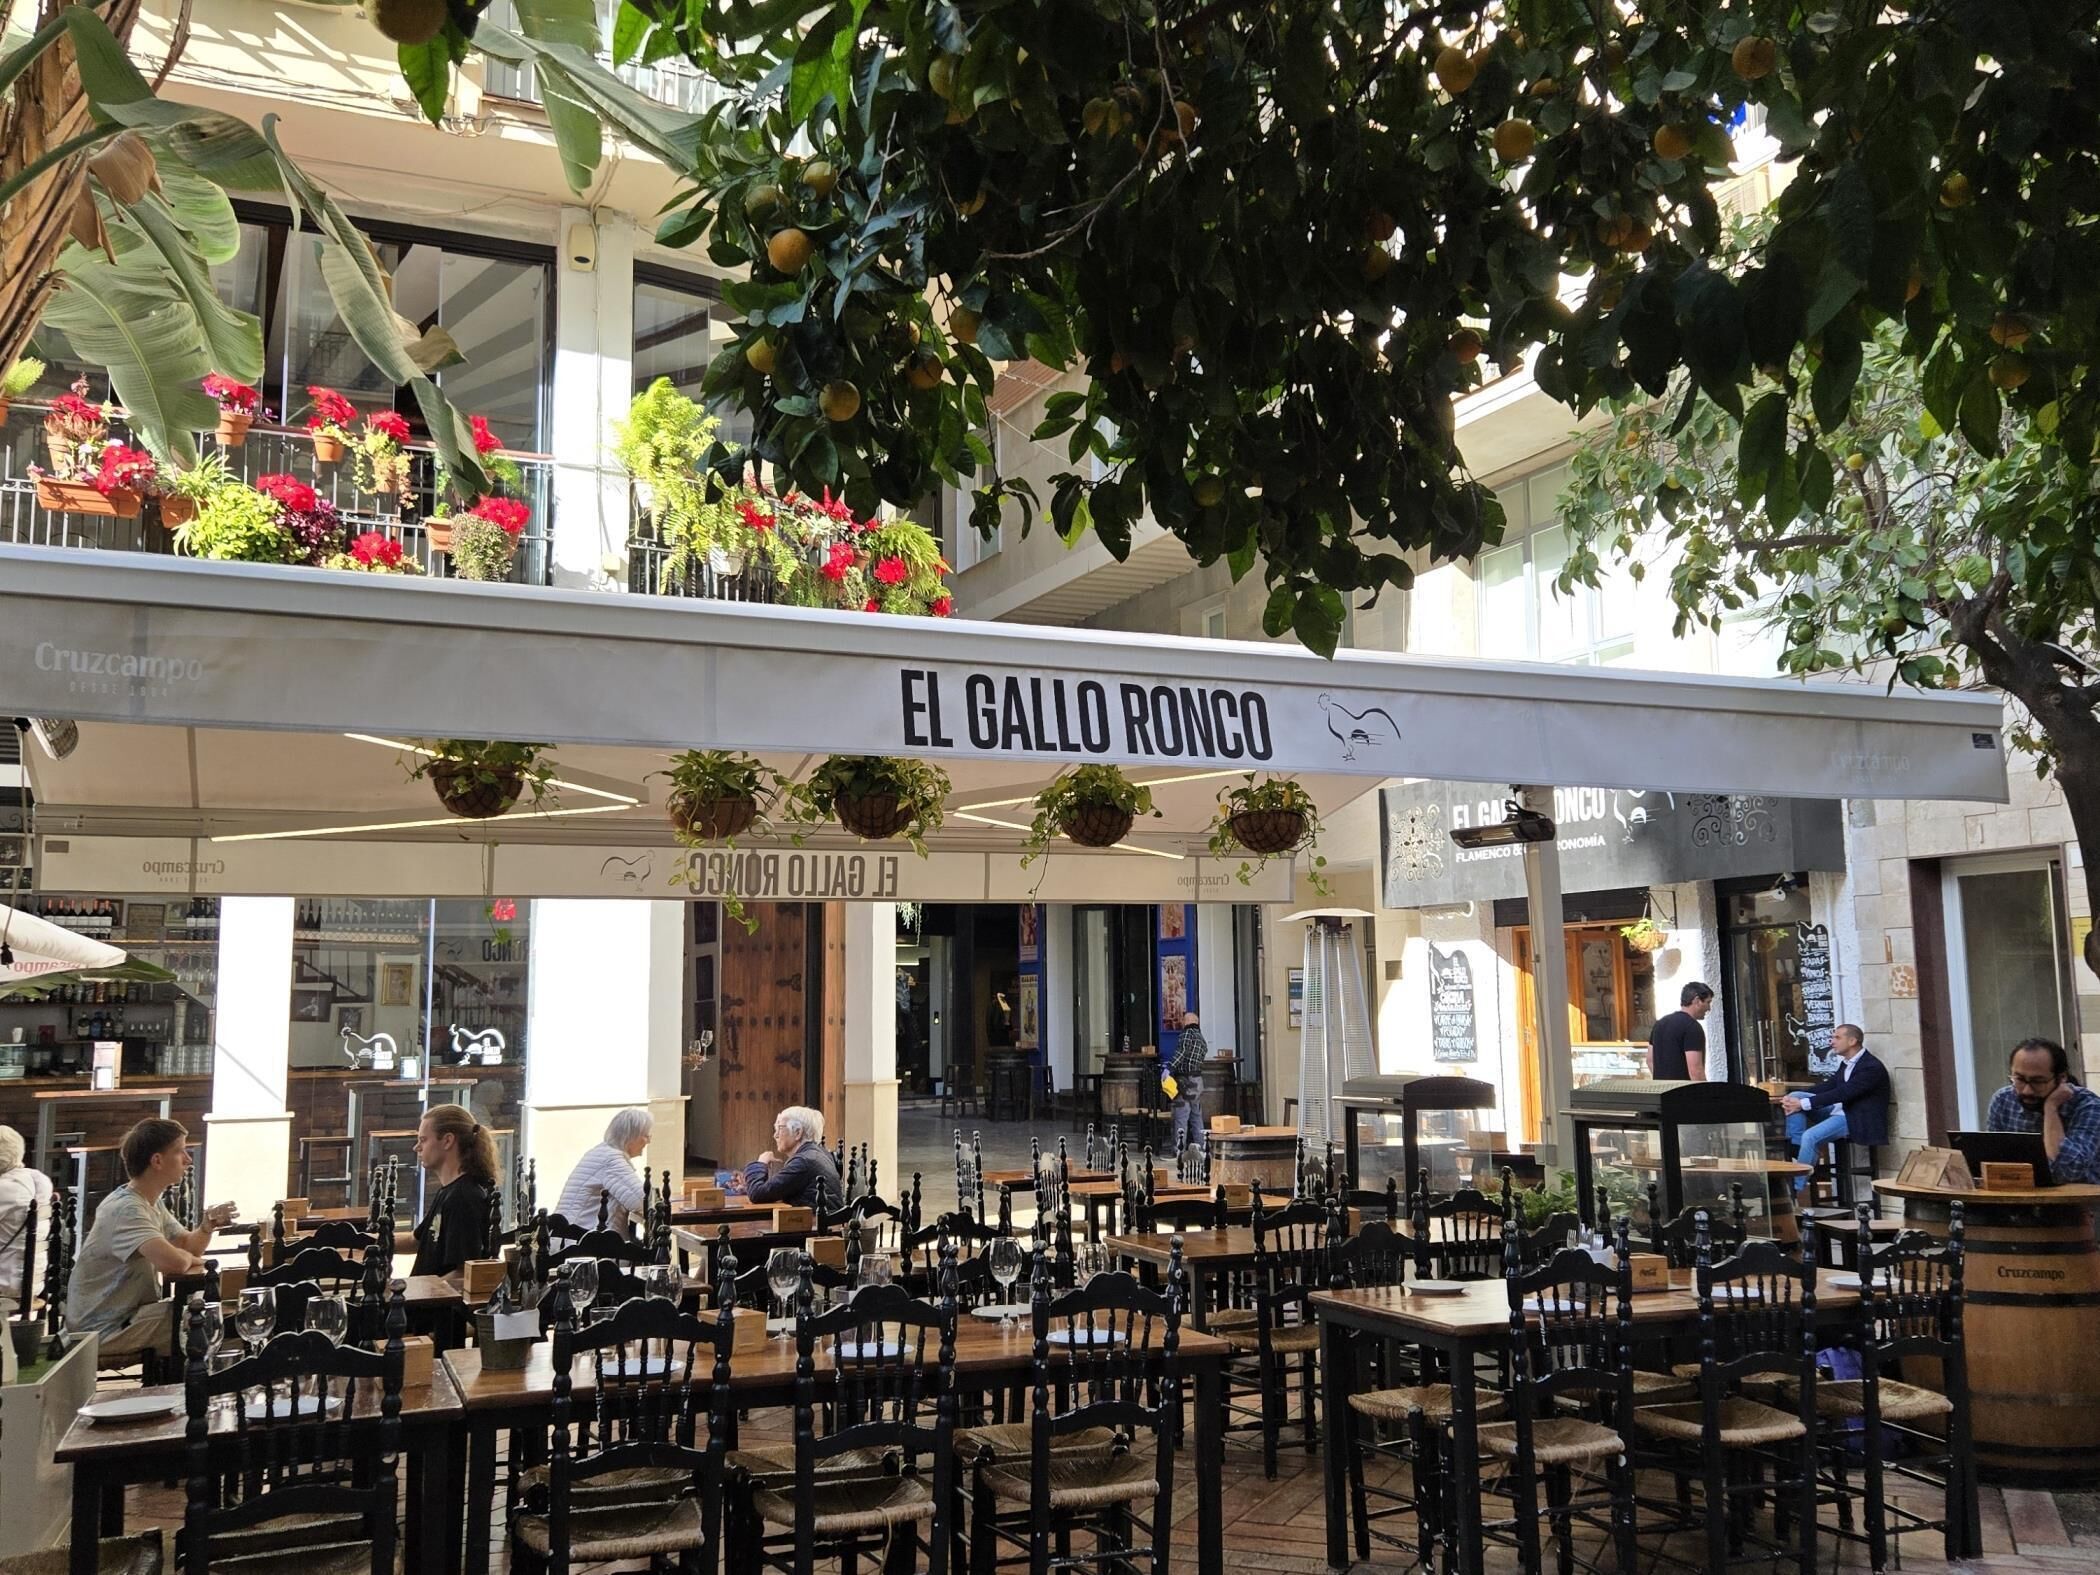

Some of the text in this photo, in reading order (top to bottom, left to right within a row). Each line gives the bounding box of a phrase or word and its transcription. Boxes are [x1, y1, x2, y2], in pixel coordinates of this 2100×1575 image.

[34, 641, 203, 685] Cruzcampo
[901, 669, 1273, 762] EL GALLO RONCO
[1554, 788, 1606, 825] ONCO
[1455, 846, 1511, 863] FLAMENCO
[1996, 1265, 2065, 1281] Cruzcampo
